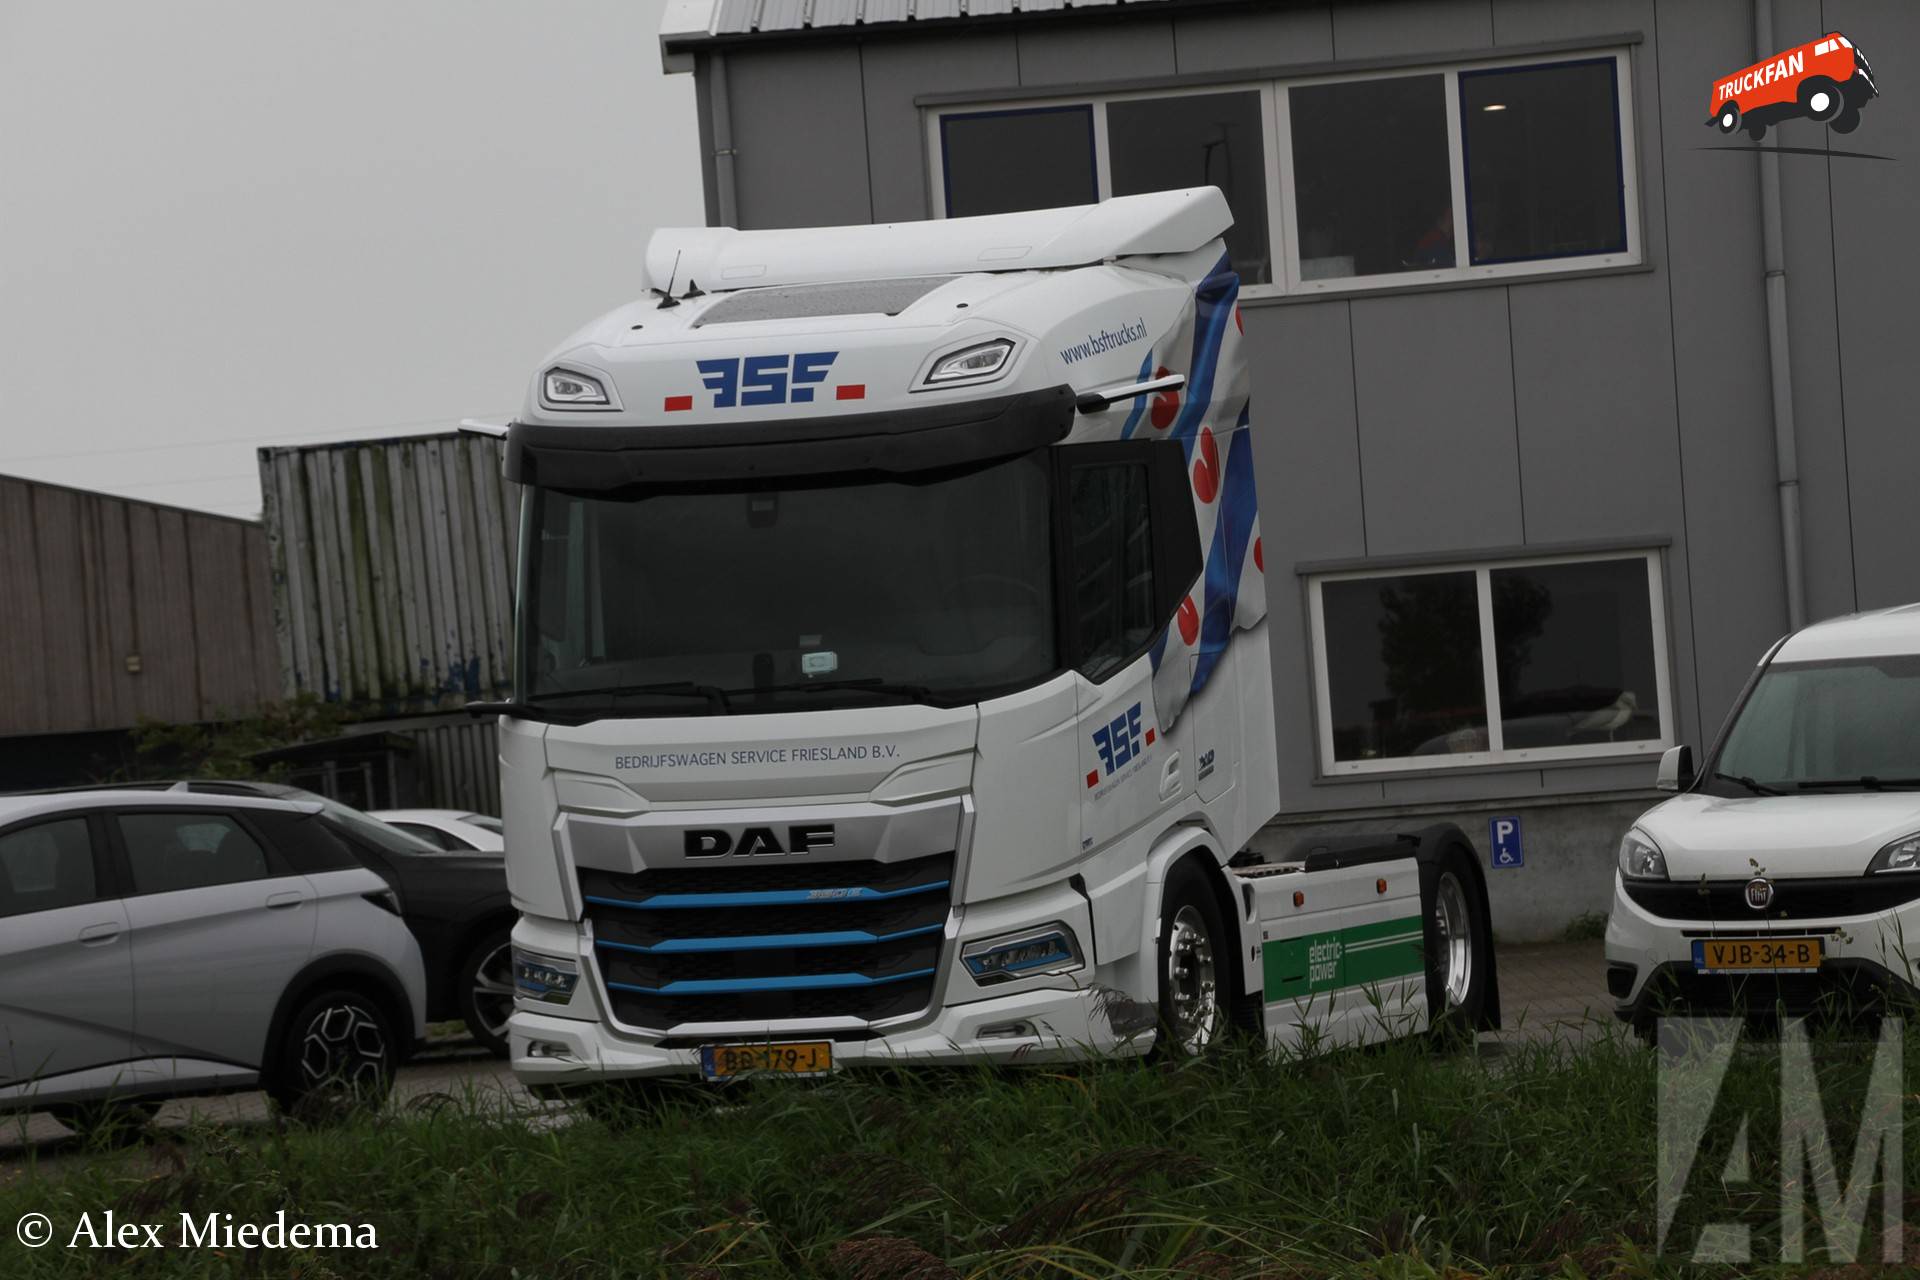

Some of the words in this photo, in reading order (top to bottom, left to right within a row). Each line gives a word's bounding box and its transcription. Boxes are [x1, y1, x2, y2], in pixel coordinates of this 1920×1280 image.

[1060, 317, 1148, 365] www.bsftrucks.nl
[615, 752, 726, 769] BEDRIJFSWAGEN
[731, 749, 786, 764] SERVICE
[791, 746, 867, 762] FRIESLAND
[872, 744, 900, 759] B.V.
[684, 824, 835, 859] DAF
[1497, 821, 1513, 844] P
[1712, 943, 1810, 965] VJB-34-B
[1309, 961, 1337, 989] power
